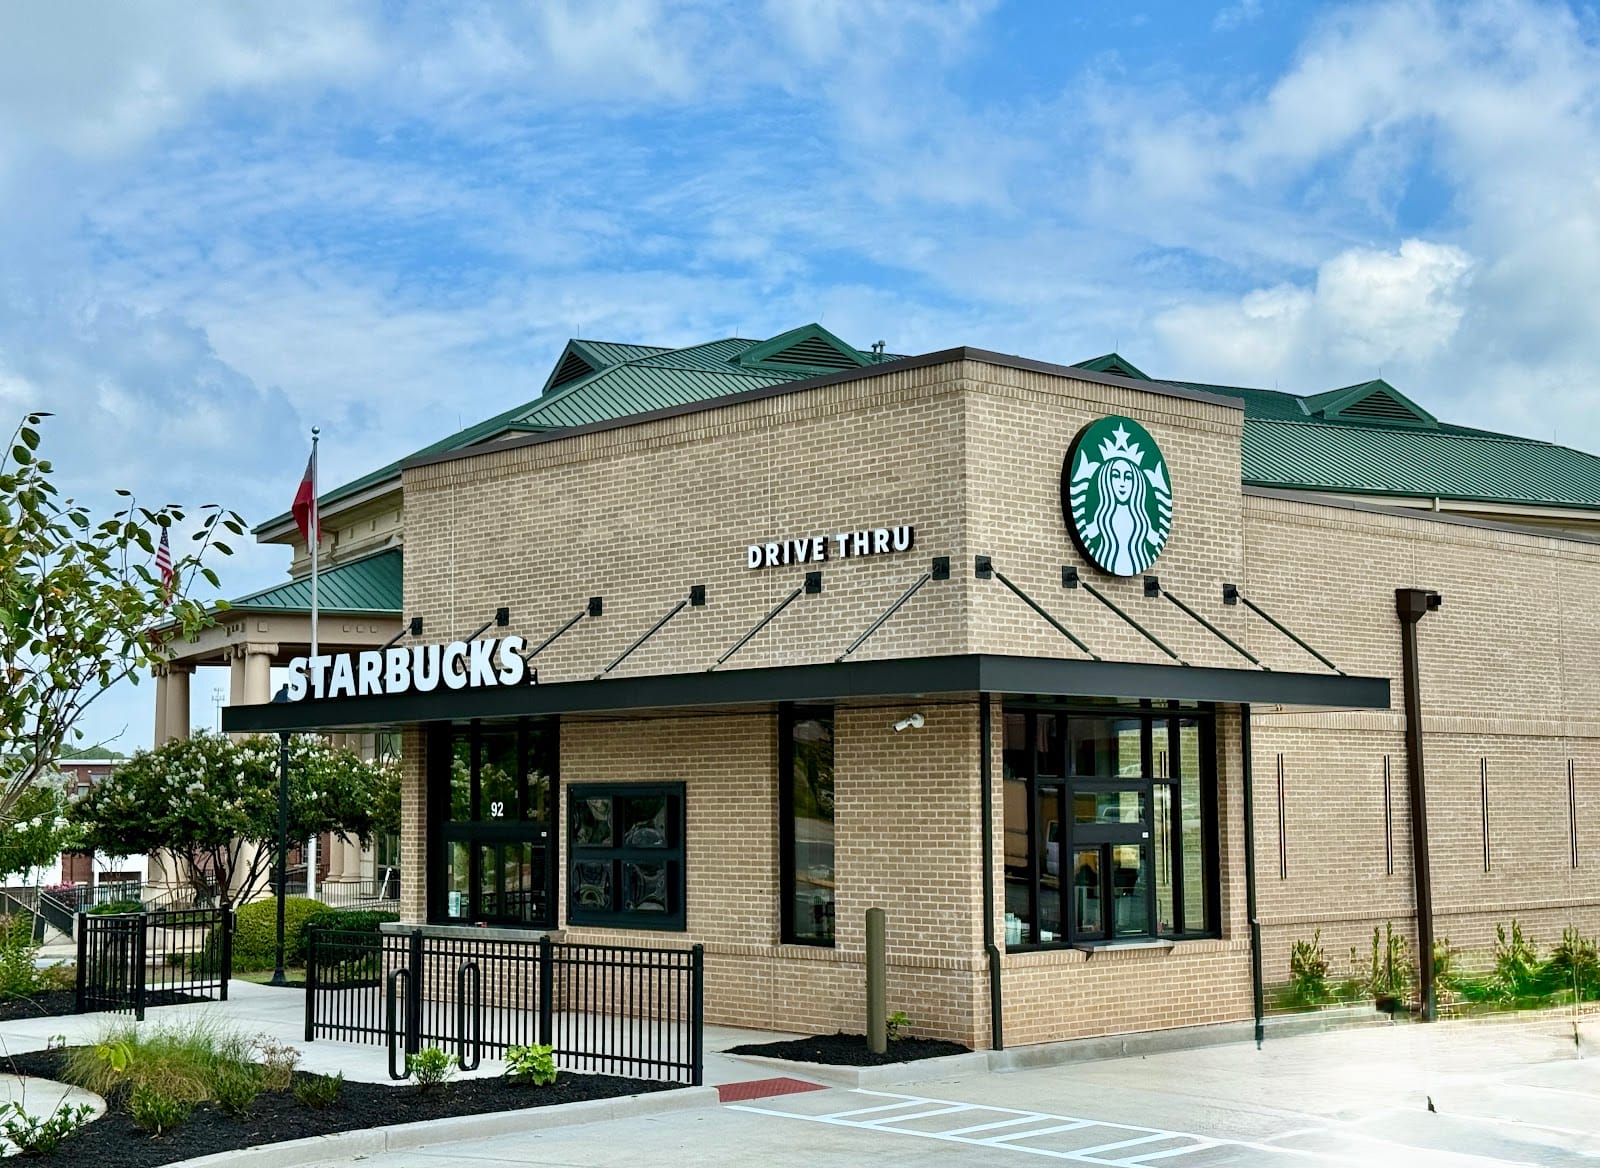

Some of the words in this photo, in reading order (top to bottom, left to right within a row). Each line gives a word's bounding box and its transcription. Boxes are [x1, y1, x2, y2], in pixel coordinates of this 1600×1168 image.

[748, 536, 826, 569] DRIVE
[836, 526, 912, 558] THRU
[288, 635, 526, 701] STARBUCKS
[490, 802, 504, 817] 92
